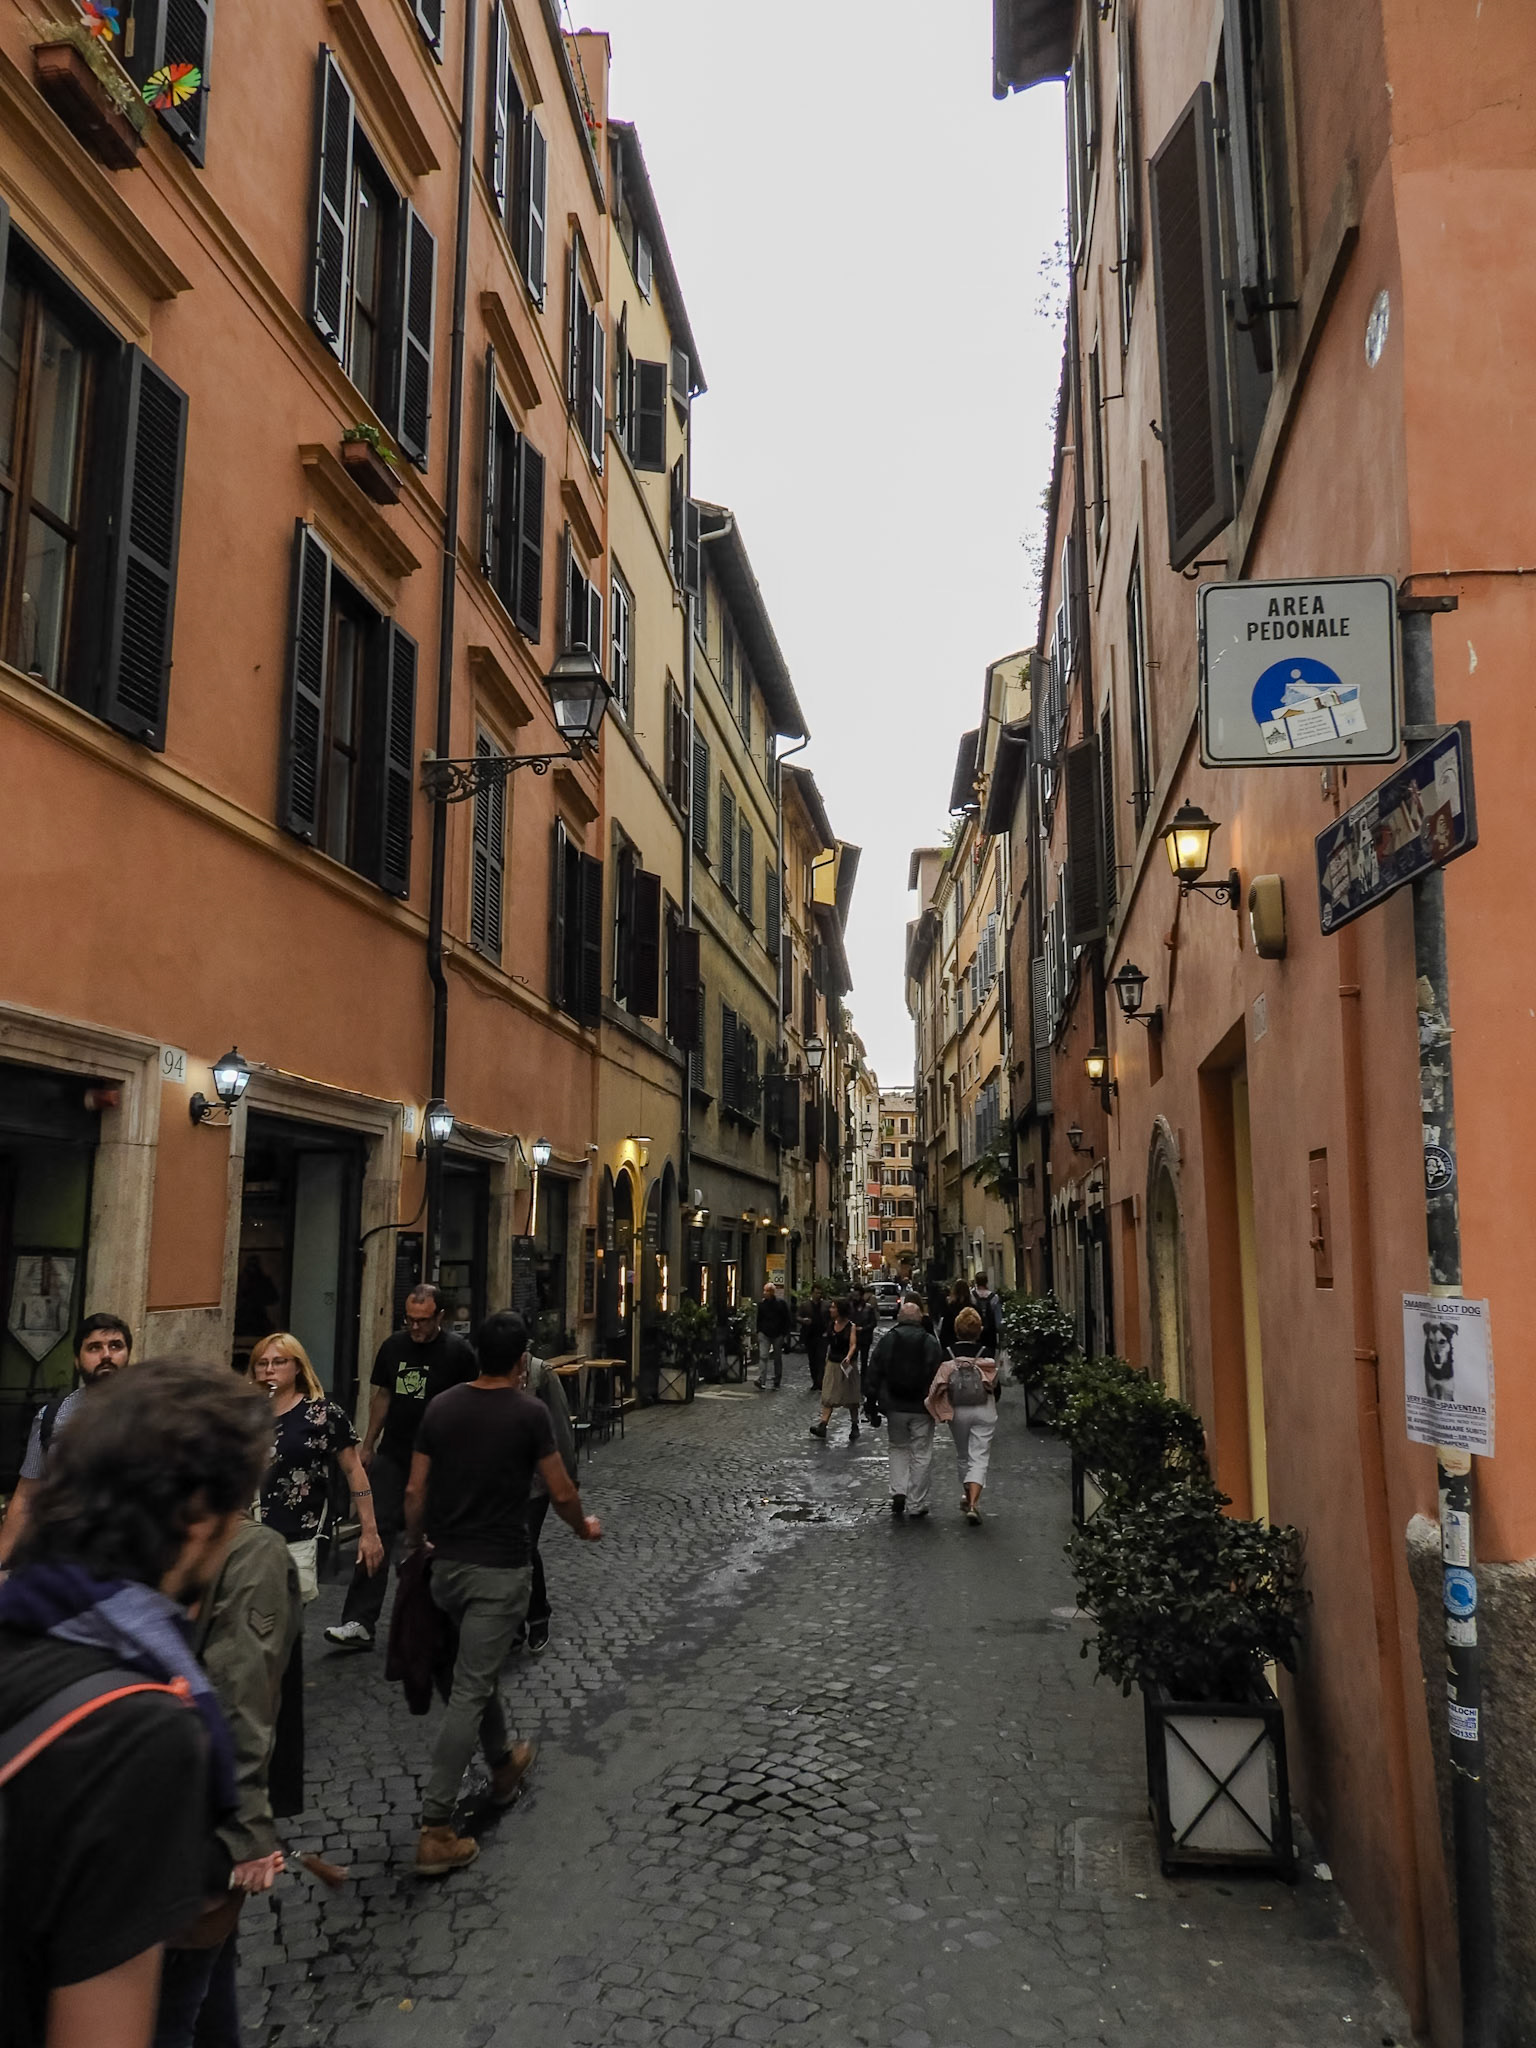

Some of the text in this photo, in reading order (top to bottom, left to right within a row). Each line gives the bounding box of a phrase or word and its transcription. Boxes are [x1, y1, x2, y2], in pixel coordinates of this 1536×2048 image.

[1268, 595, 1325, 617] AREA
[1247, 617, 1350, 641] PEDONALE
[163, 1051, 183, 1077] 94
[1437, 1304, 1459, 1313] LOST
[1461, 1306, 1481, 1315] DOG
[1440, 1402, 1487, 1413] SPAVENTATA
